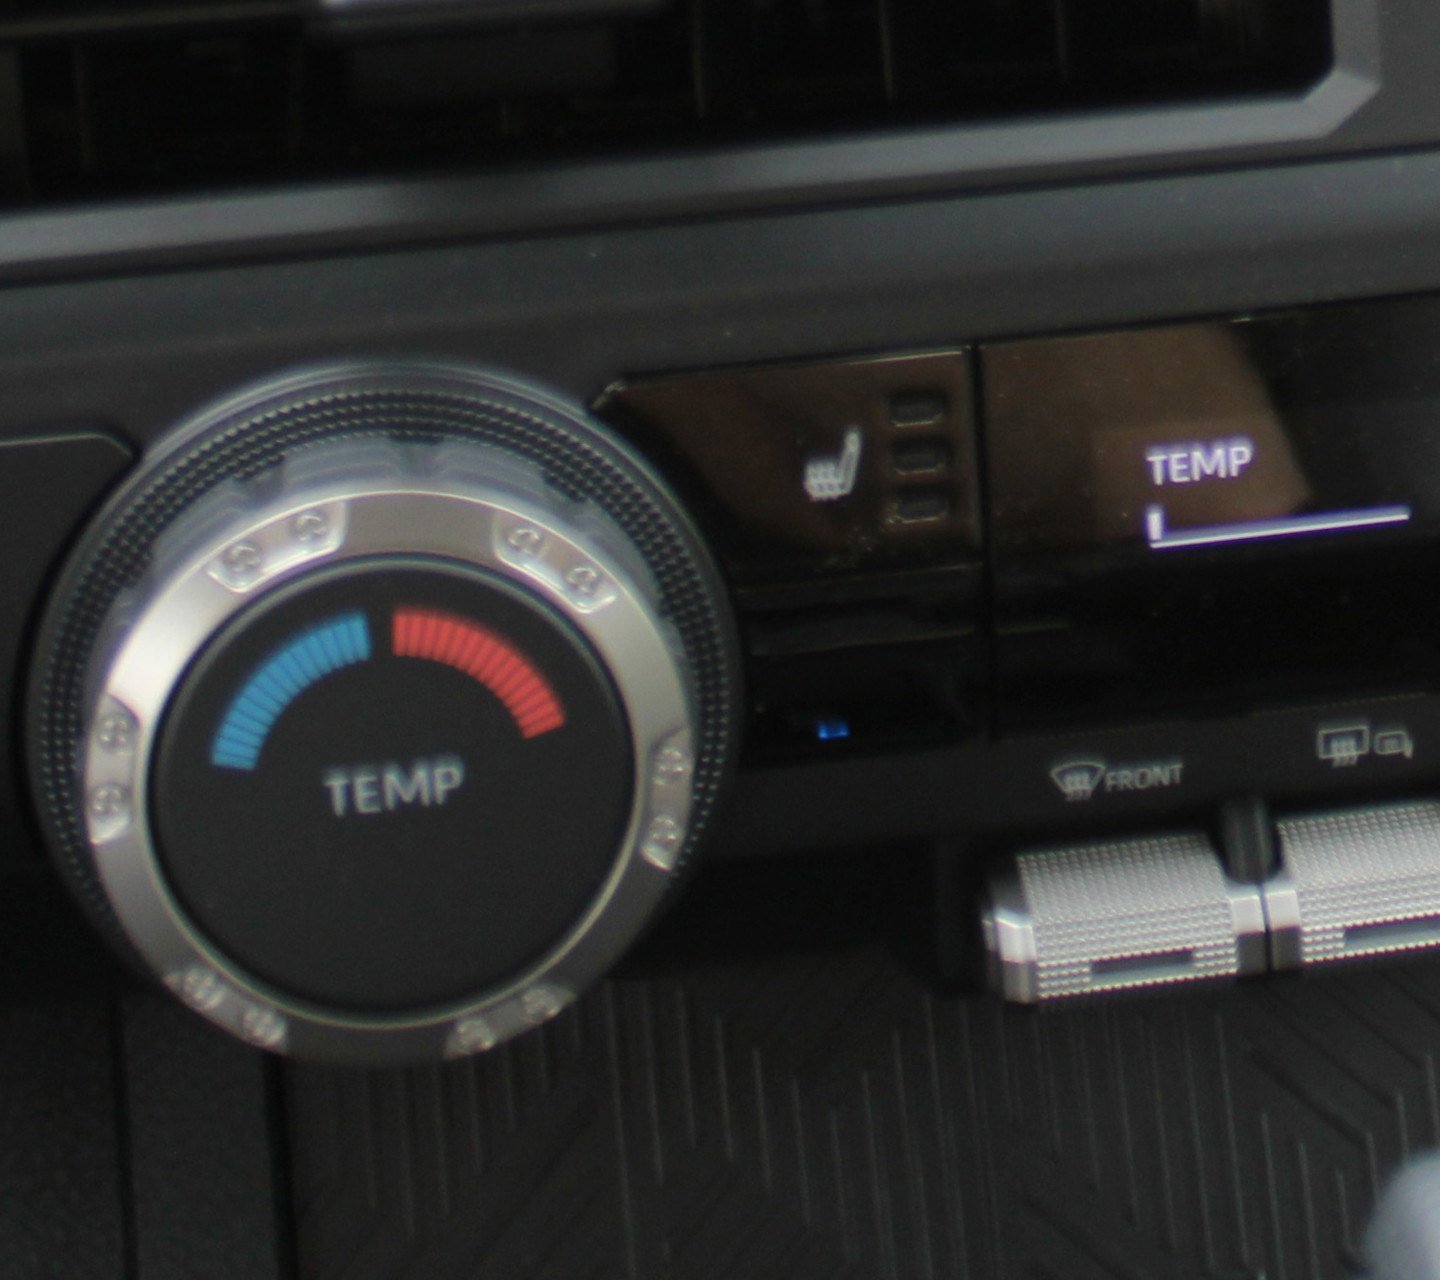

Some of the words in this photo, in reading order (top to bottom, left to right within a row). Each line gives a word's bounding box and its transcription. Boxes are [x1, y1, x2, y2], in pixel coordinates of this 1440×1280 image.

[1146, 436, 1254, 486] TEMP
[324, 754, 461, 816] TEMP
[1105, 762, 1183, 792] FRONT
